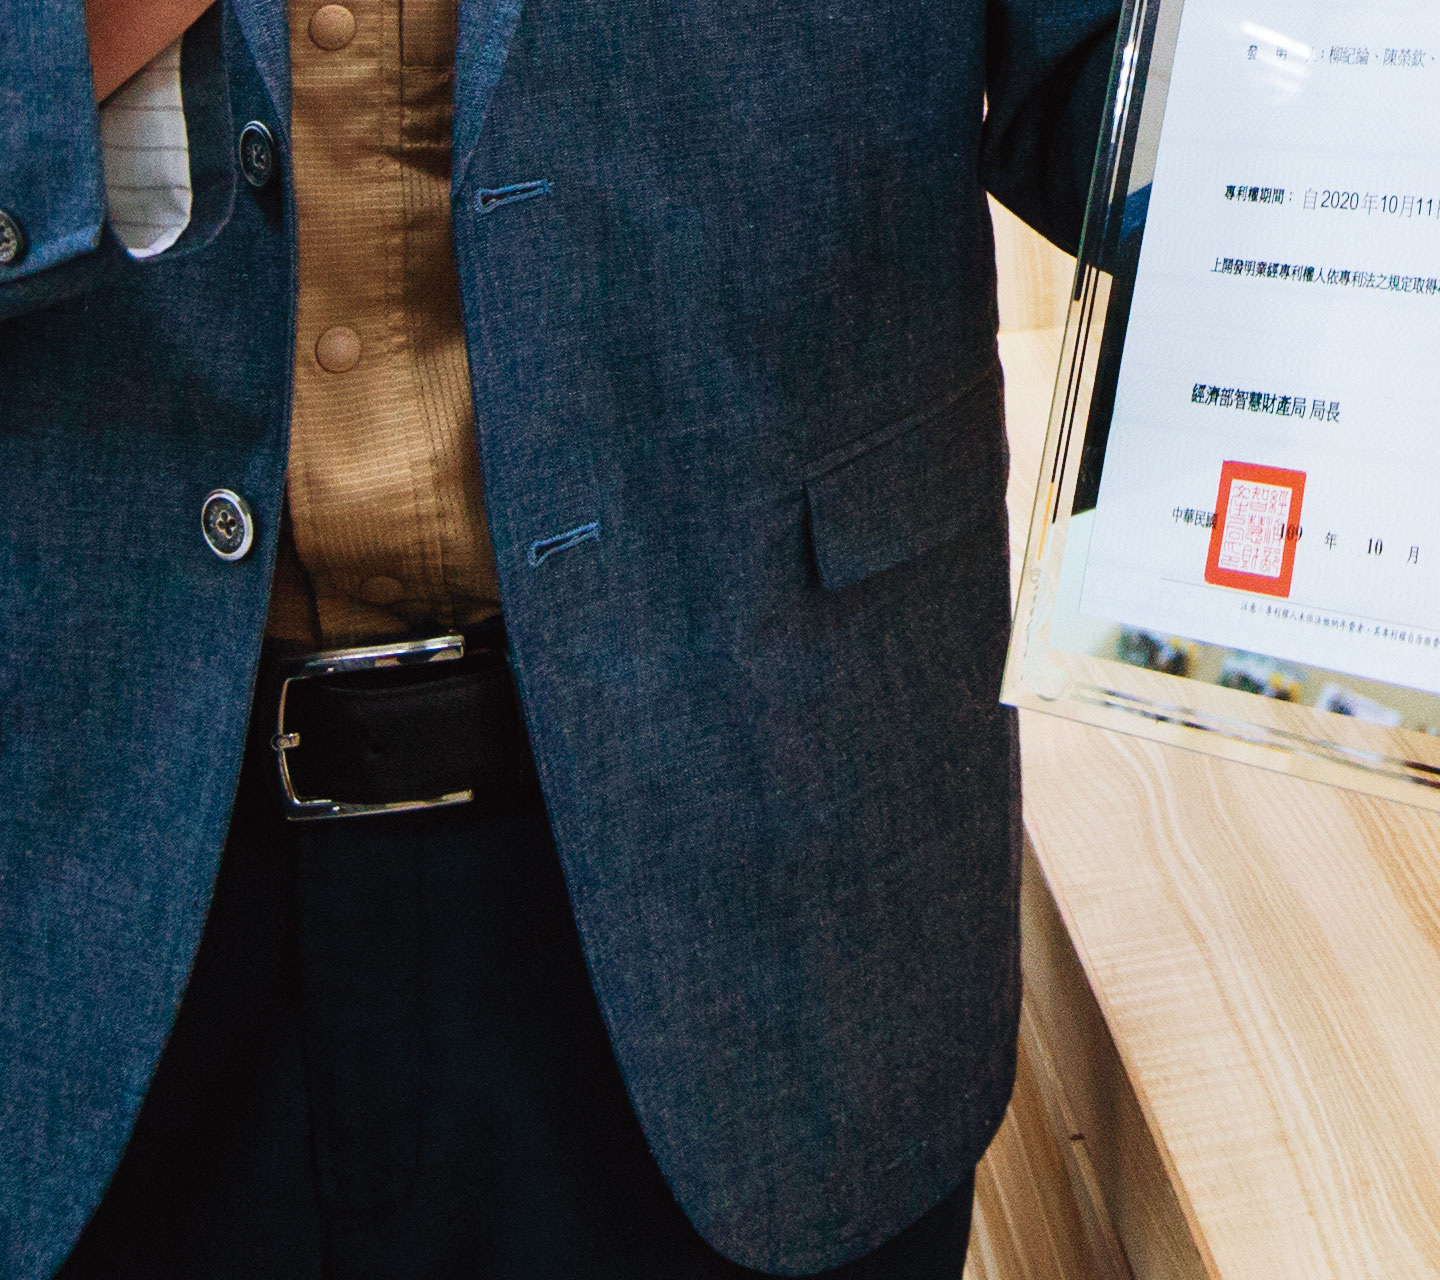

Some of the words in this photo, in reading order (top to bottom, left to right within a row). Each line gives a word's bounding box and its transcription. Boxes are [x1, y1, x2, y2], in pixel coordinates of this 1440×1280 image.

[1191, 382, 1306, 419] 經濟部智慧財產局
[1309, 398, 1341, 424] 局長
[1324, 532, 1337, 550] 年
[1367, 537, 1383, 556] 10
[1408, 546, 1420, 565] 月
